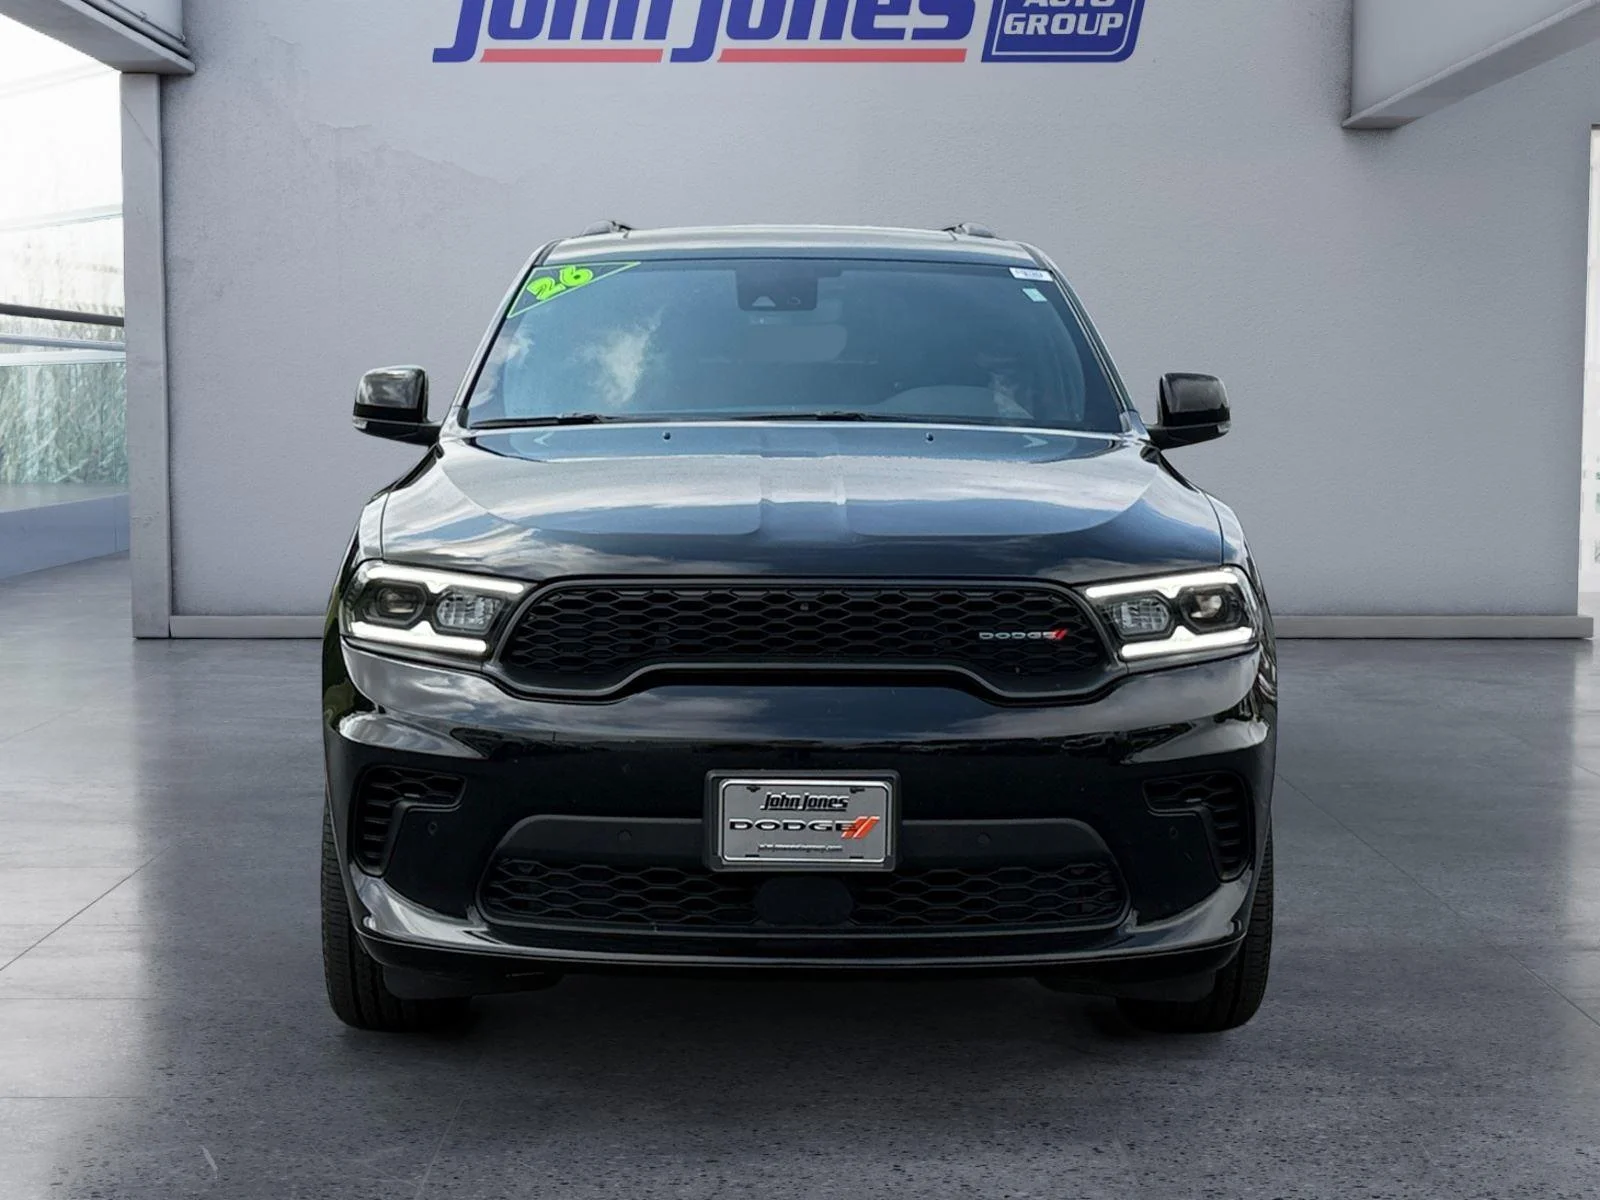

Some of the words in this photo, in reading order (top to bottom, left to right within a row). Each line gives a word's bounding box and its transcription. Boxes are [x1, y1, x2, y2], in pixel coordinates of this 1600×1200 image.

[1003, 12, 1124, 36] GROUP
[526, 264, 594, 301] 26
[979, 631, 1058, 640] DODGE
[760, 792, 801, 810] John
[798, 792, 850, 811] Jones
[728, 818, 858, 832] DODGE
